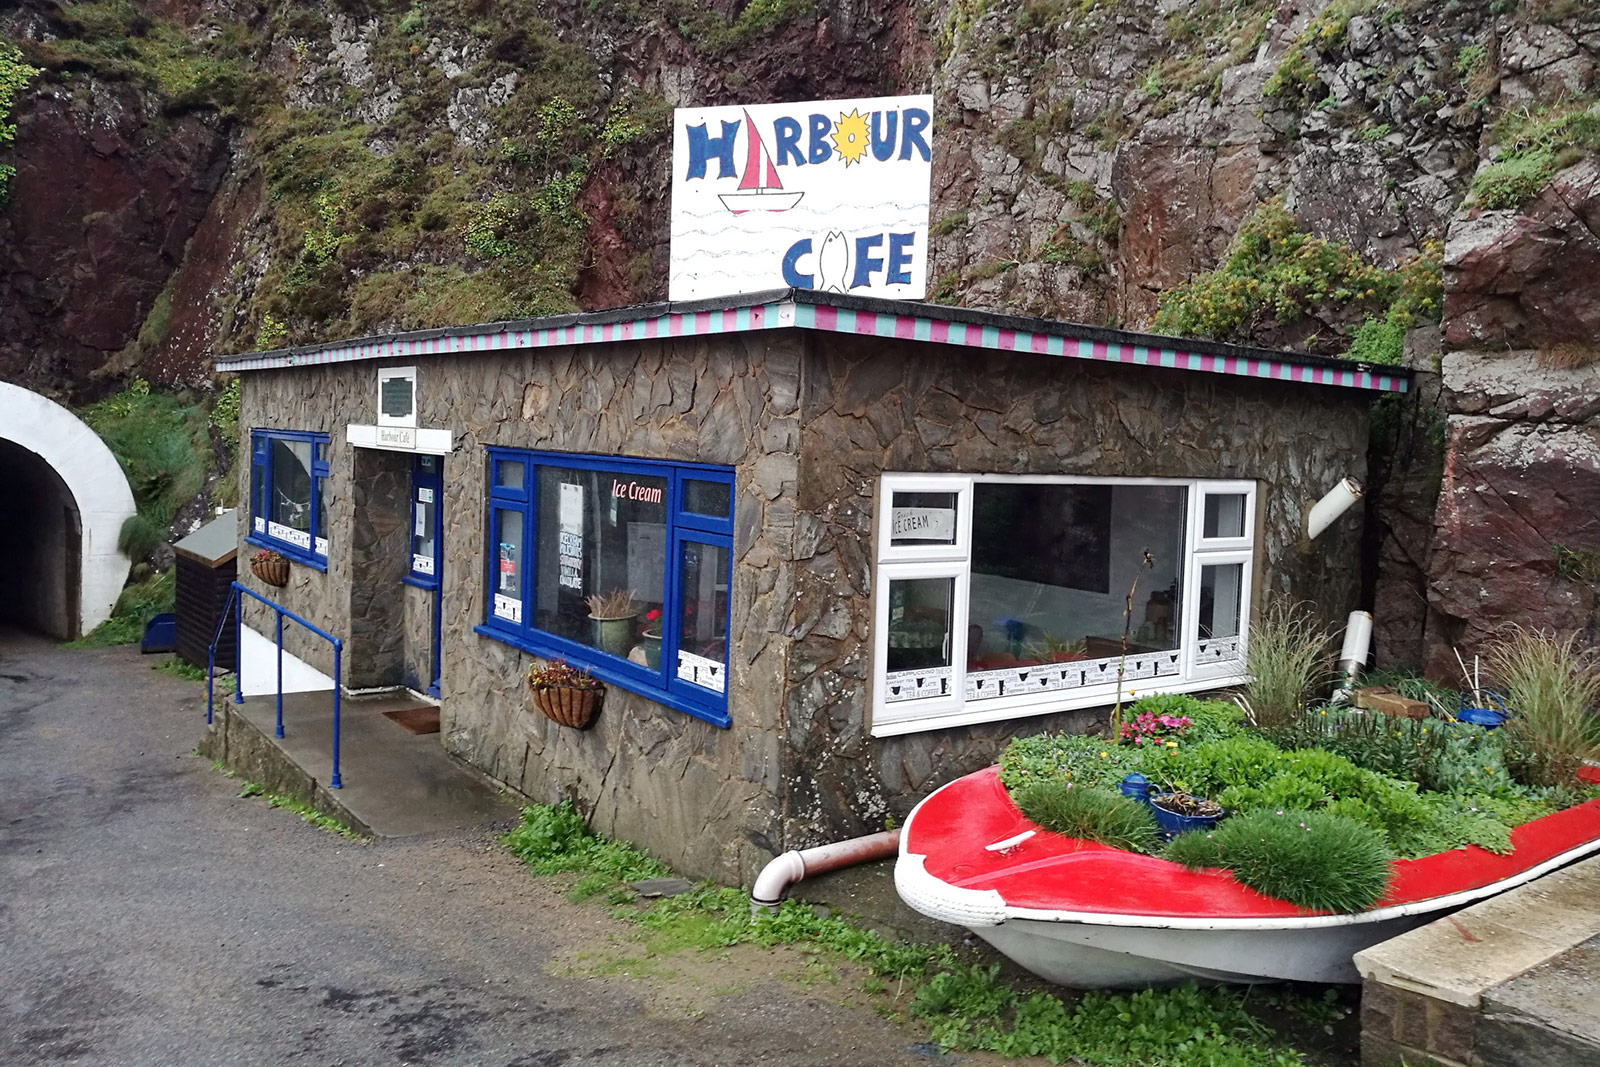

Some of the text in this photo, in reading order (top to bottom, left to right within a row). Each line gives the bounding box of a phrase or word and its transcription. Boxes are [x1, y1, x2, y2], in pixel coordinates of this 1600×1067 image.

[612, 479, 662, 504] Ice Cream
[903, 515, 929, 532] CREAM
[897, 669, 935, 678] CAPPUCCINO
[921, 687, 940, 697] COFFEE
